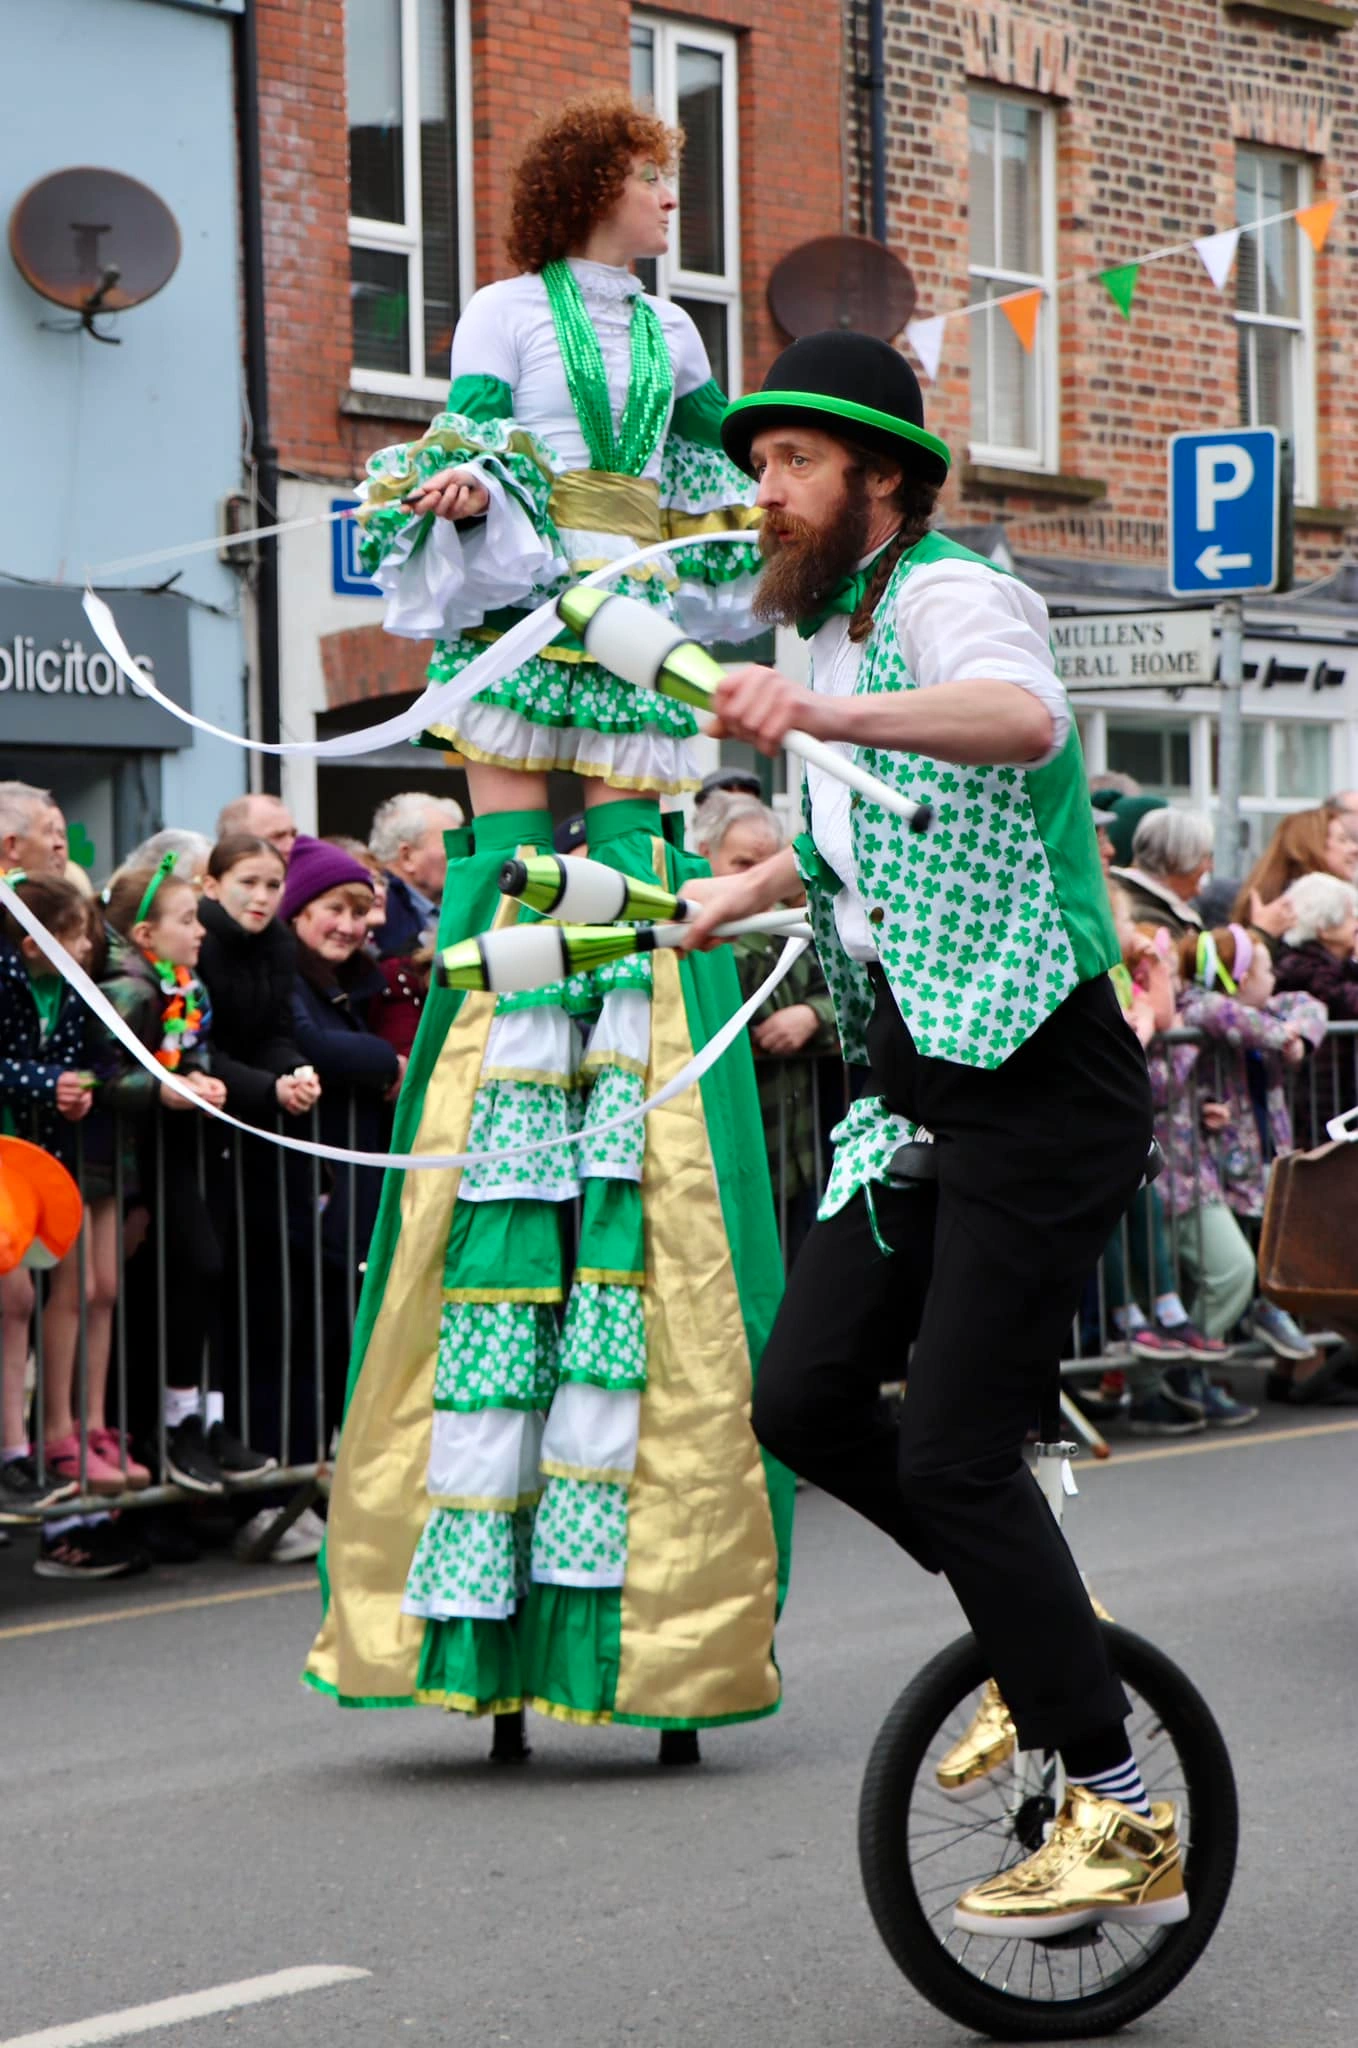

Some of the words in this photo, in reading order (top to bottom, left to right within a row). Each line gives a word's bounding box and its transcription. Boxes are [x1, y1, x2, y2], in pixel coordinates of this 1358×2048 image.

[1195, 444, 1255, 532] P
[1060, 655, 1119, 678] ERAL
[1130, 650, 1200, 675] HOME
